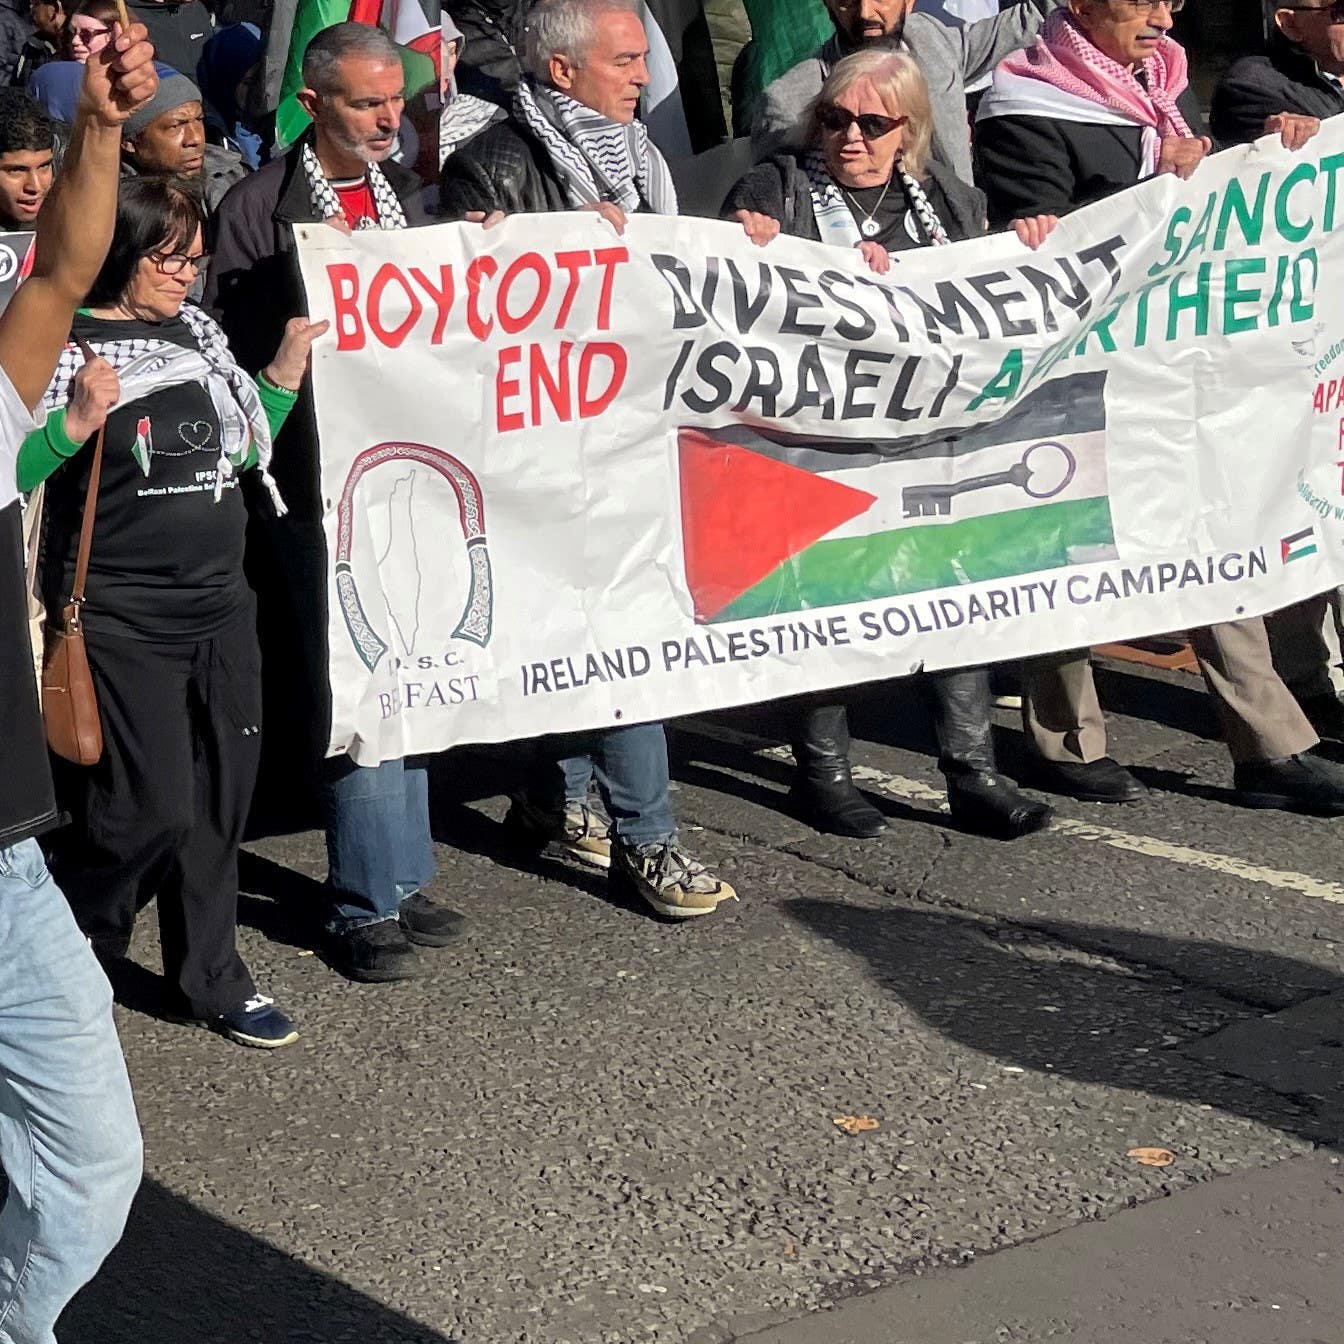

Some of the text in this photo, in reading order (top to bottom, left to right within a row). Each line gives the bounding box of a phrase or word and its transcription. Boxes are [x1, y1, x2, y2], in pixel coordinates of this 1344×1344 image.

[328, 246, 630, 353] BOYCOTT
[650, 234, 1128, 346] DIVESTMENT
[494, 341, 630, 435] END
[663, 338, 964, 423] ISRAELI
[519, 545, 1269, 698] IRELAND PALESTINE SOLIDARITY CAMPAIGN
